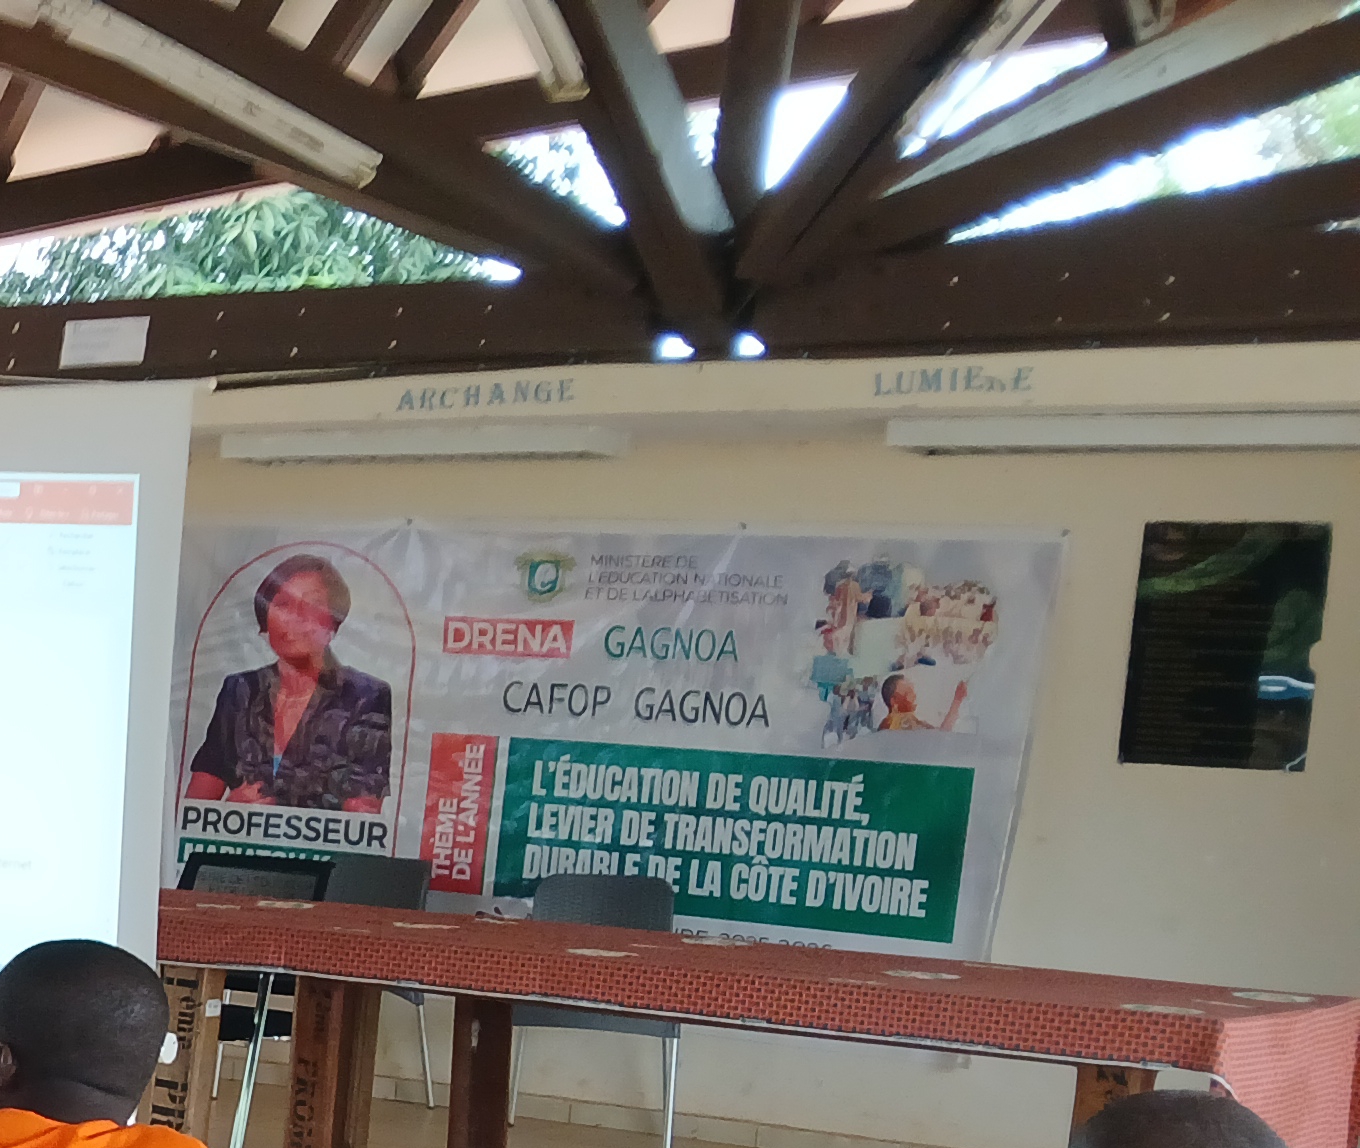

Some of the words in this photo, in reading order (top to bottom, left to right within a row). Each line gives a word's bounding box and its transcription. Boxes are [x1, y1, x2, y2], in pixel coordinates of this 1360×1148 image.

[396, 378, 576, 412] ARCHANGE
[676, 555, 700, 569] DE
[584, 587, 604, 600] ET
[607, 587, 629, 601] DE
[694, 573, 784, 589] NTIONALE
[447, 621, 568, 654] DRENA
[604, 625, 739, 663] GAGNOA
[502, 680, 612, 718] CAFOP
[634, 686, 770, 728] GAGNOA
[532, 754, 700, 808] L'ÉDUCATION
[706, 773, 743, 812] DE
[748, 773, 871, 826] QUALITÉ,
[181, 805, 388, 849] PROFESSEUR
[527, 802, 615, 844] LEVIER
[620, 810, 655, 847] DE
[663, 812, 919, 872] TRANSFORMATION
[452, 847, 474, 881] DE
[647, 854, 683, 894] DE
[687, 858, 722, 899] LA
[730, 855, 798, 905] CÔTE
[805, 869, 930, 918] D'IVOIRE
